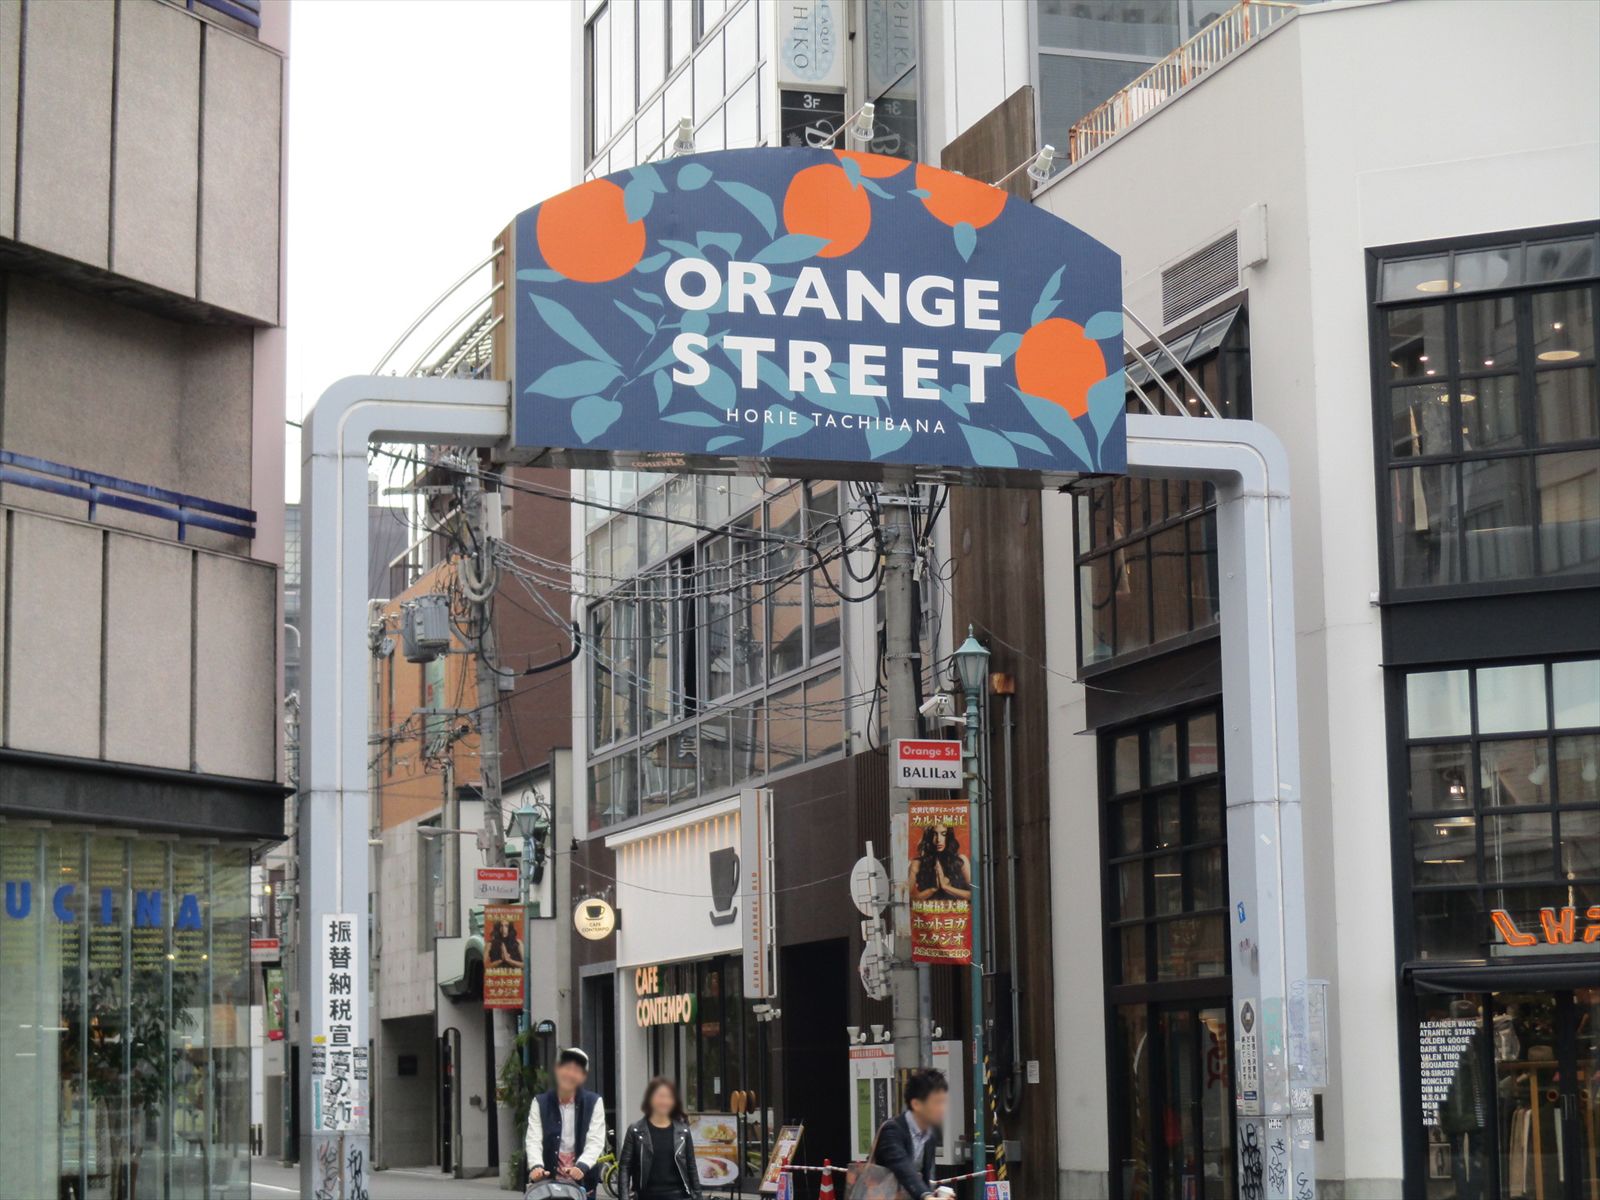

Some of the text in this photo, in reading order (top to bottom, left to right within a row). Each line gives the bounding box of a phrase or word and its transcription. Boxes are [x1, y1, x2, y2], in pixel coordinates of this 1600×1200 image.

[793, 6, 809, 69] HIKO
[820, 18, 830, 54] AQUA
[803, 94, 821, 109] 3F
[664, 257, 1001, 331] ORANGE
[671, 332, 1002, 403] STREET
[726, 408, 946, 434] HORIE TACHIBANA
[902, 746, 958, 759] Orange St.
[902, 766, 957, 779] BALILax
[913, 917, 967, 930] ホットヨガ
[919, 932, 965, 945] スタジオ
[635, 966, 659, 996] CAFE
[636, 993, 692, 1027] CONTEMPO
[1447, 1036, 1470, 1044] GOOSE
[1420, 1045, 1438, 1053] DARK
[1420, 1052, 1460, 1061] VALEN TINO
[1420, 1061, 1459, 1069] DSQUARED2
[1421, 1077, 1452, 1085] MONCLER
[1421, 1085, 1449, 1093] DIM MAK
[1423, 1118, 1438, 1126] HBA
